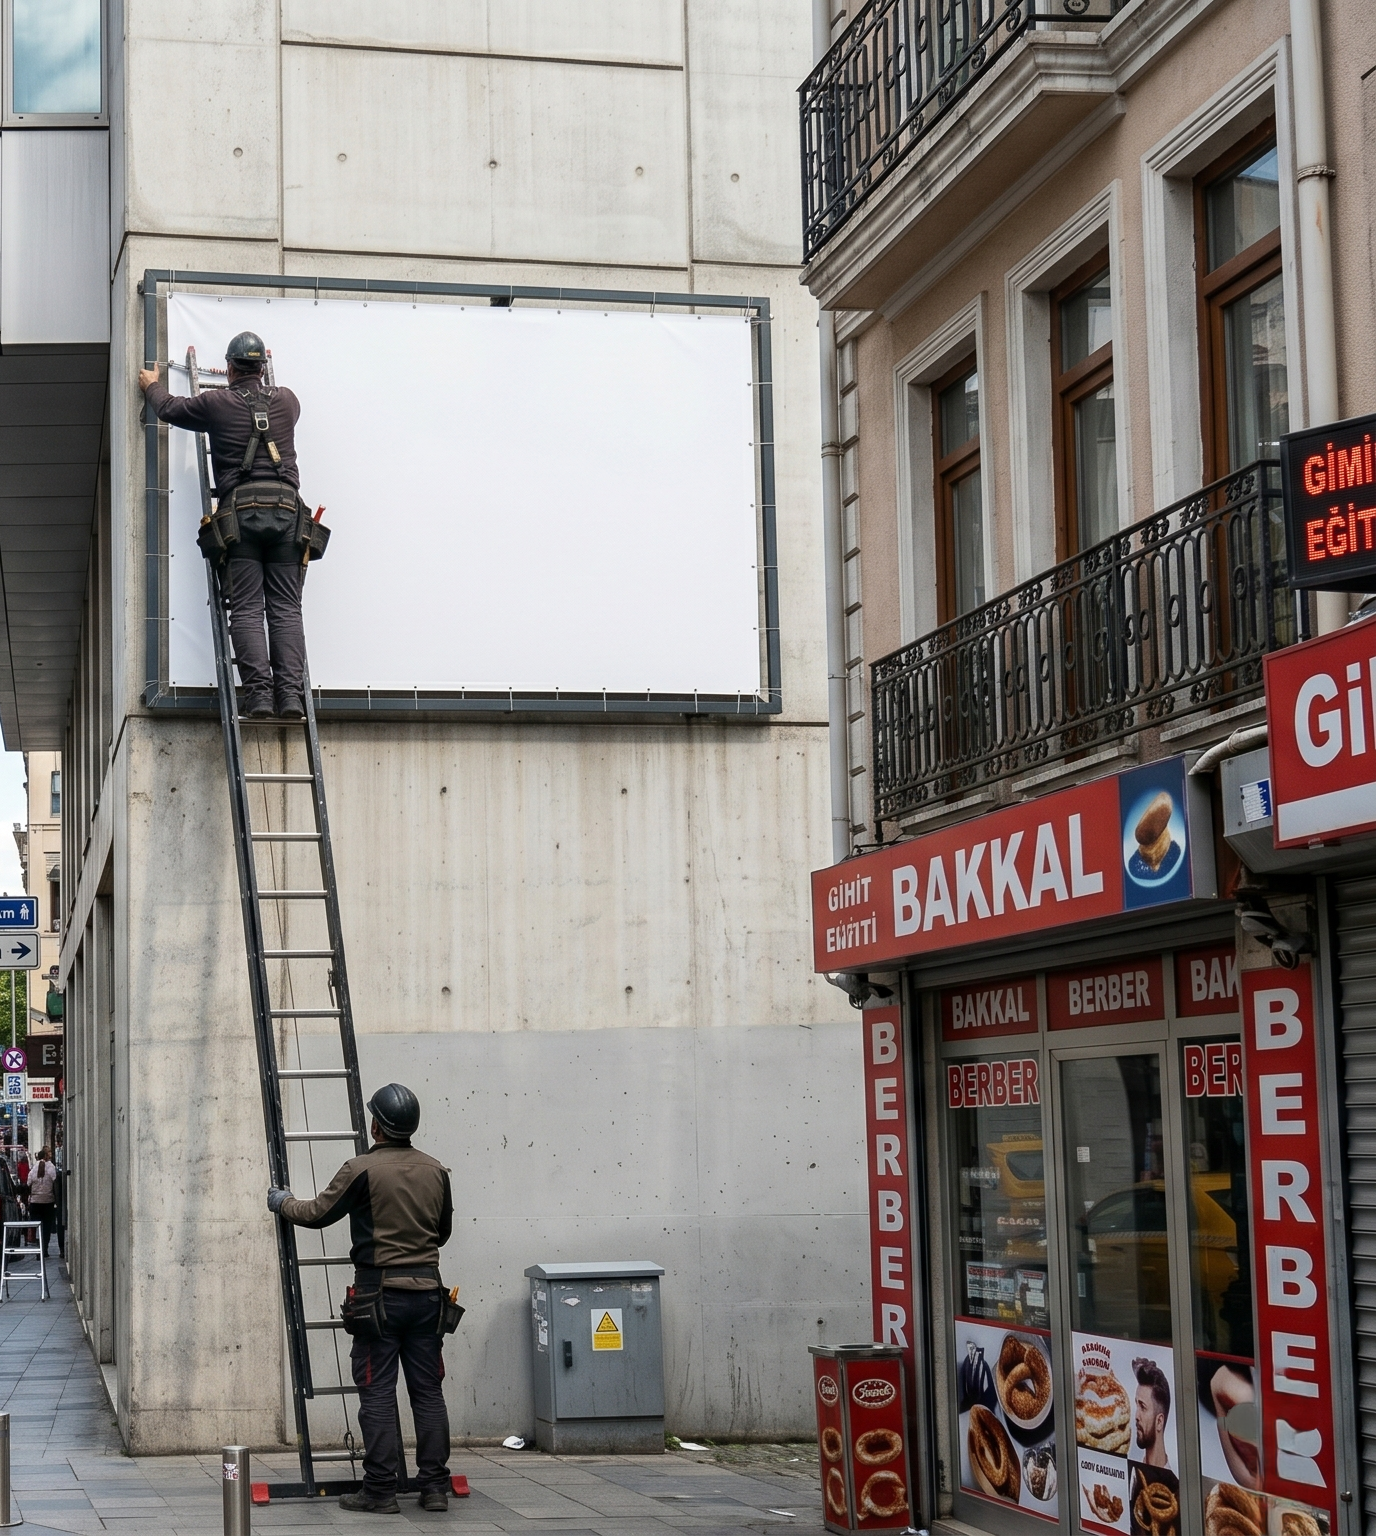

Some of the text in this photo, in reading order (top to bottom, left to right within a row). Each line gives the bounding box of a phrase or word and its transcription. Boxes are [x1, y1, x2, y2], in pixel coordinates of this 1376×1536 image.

[1304, 434, 1376, 495] GİMİ
[892, 812, 1104, 938] BAKKAL
[1068, 970, 1151, 1016] BERBER
[1190, 955, 1240, 1002] BAK
[952, 986, 1030, 1030] BAKKAL
[947, 1058, 1041, 1109] BERBER
[1184, 1042, 1244, 1098] BER
[871, 1021, 909, 1348] BERBER
